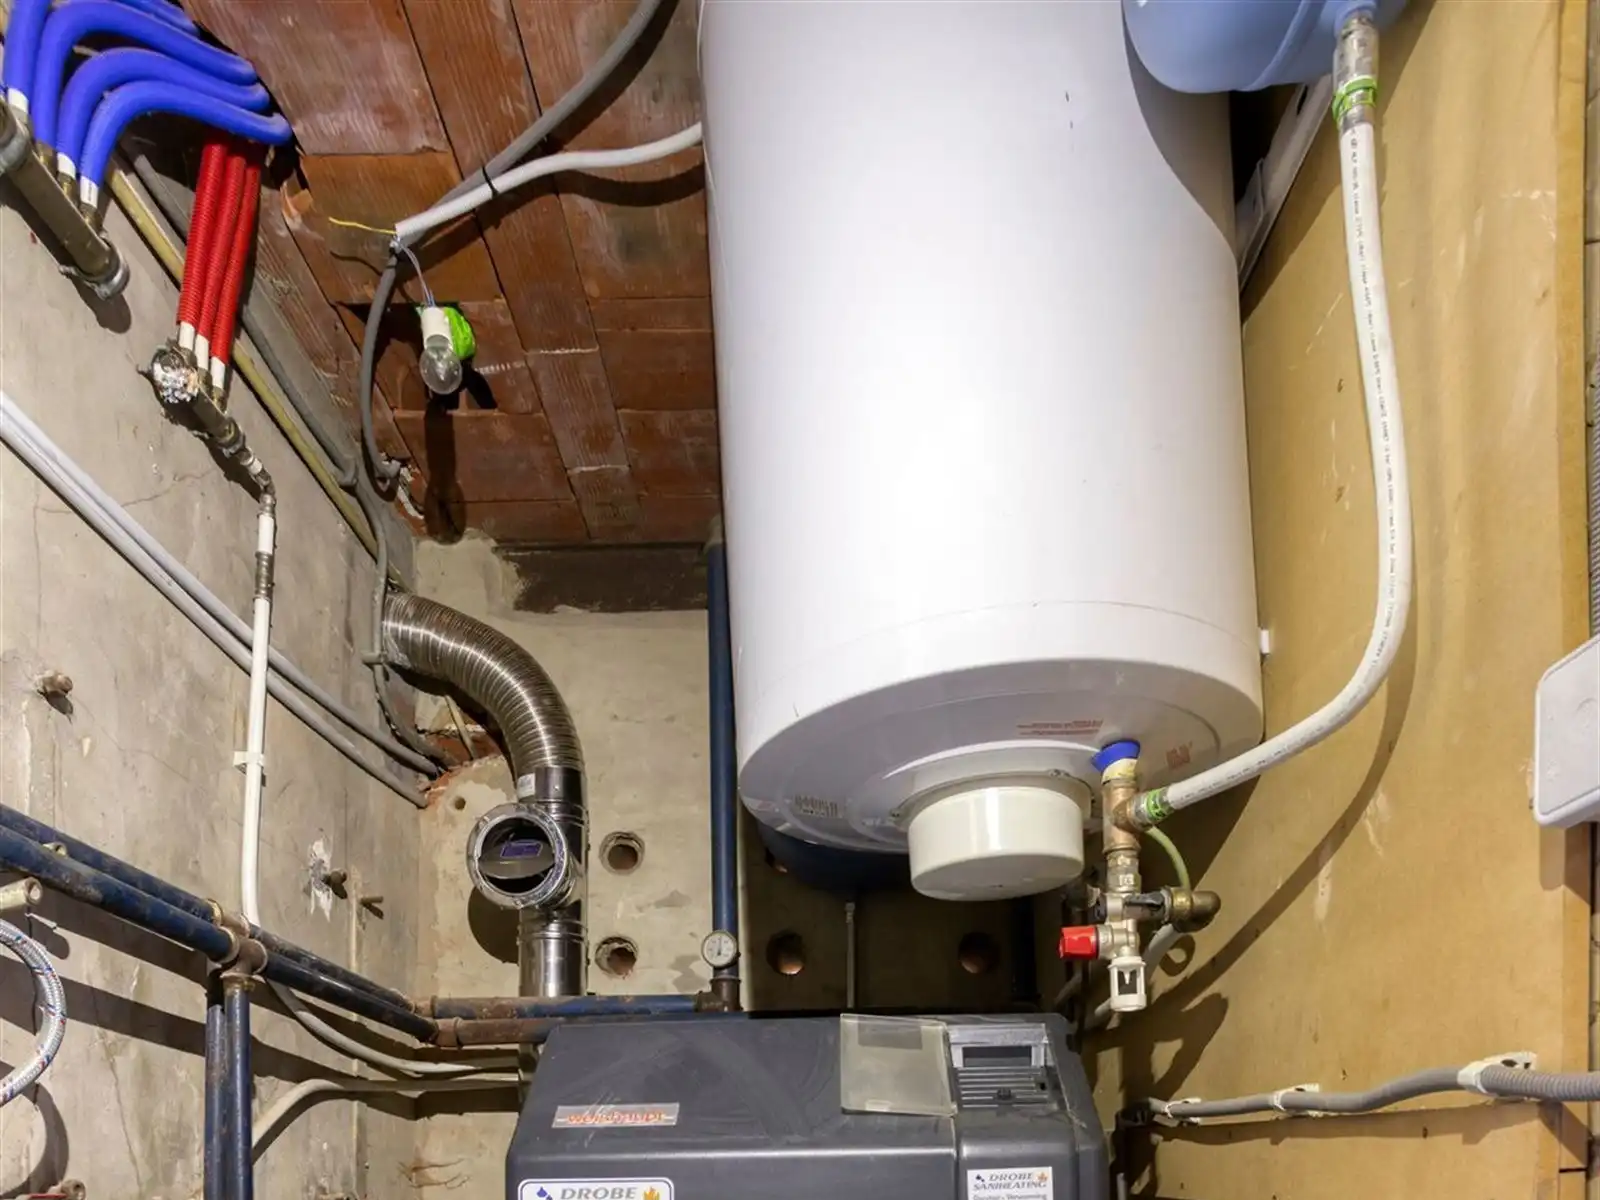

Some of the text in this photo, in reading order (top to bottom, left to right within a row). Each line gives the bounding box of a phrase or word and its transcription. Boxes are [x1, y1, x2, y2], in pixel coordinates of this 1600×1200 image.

[989, 1173, 1033, 1182] DROBE
[973, 1181, 1047, 1190] SANIHEATING
[560, 1186, 637, 1200] DROBE
